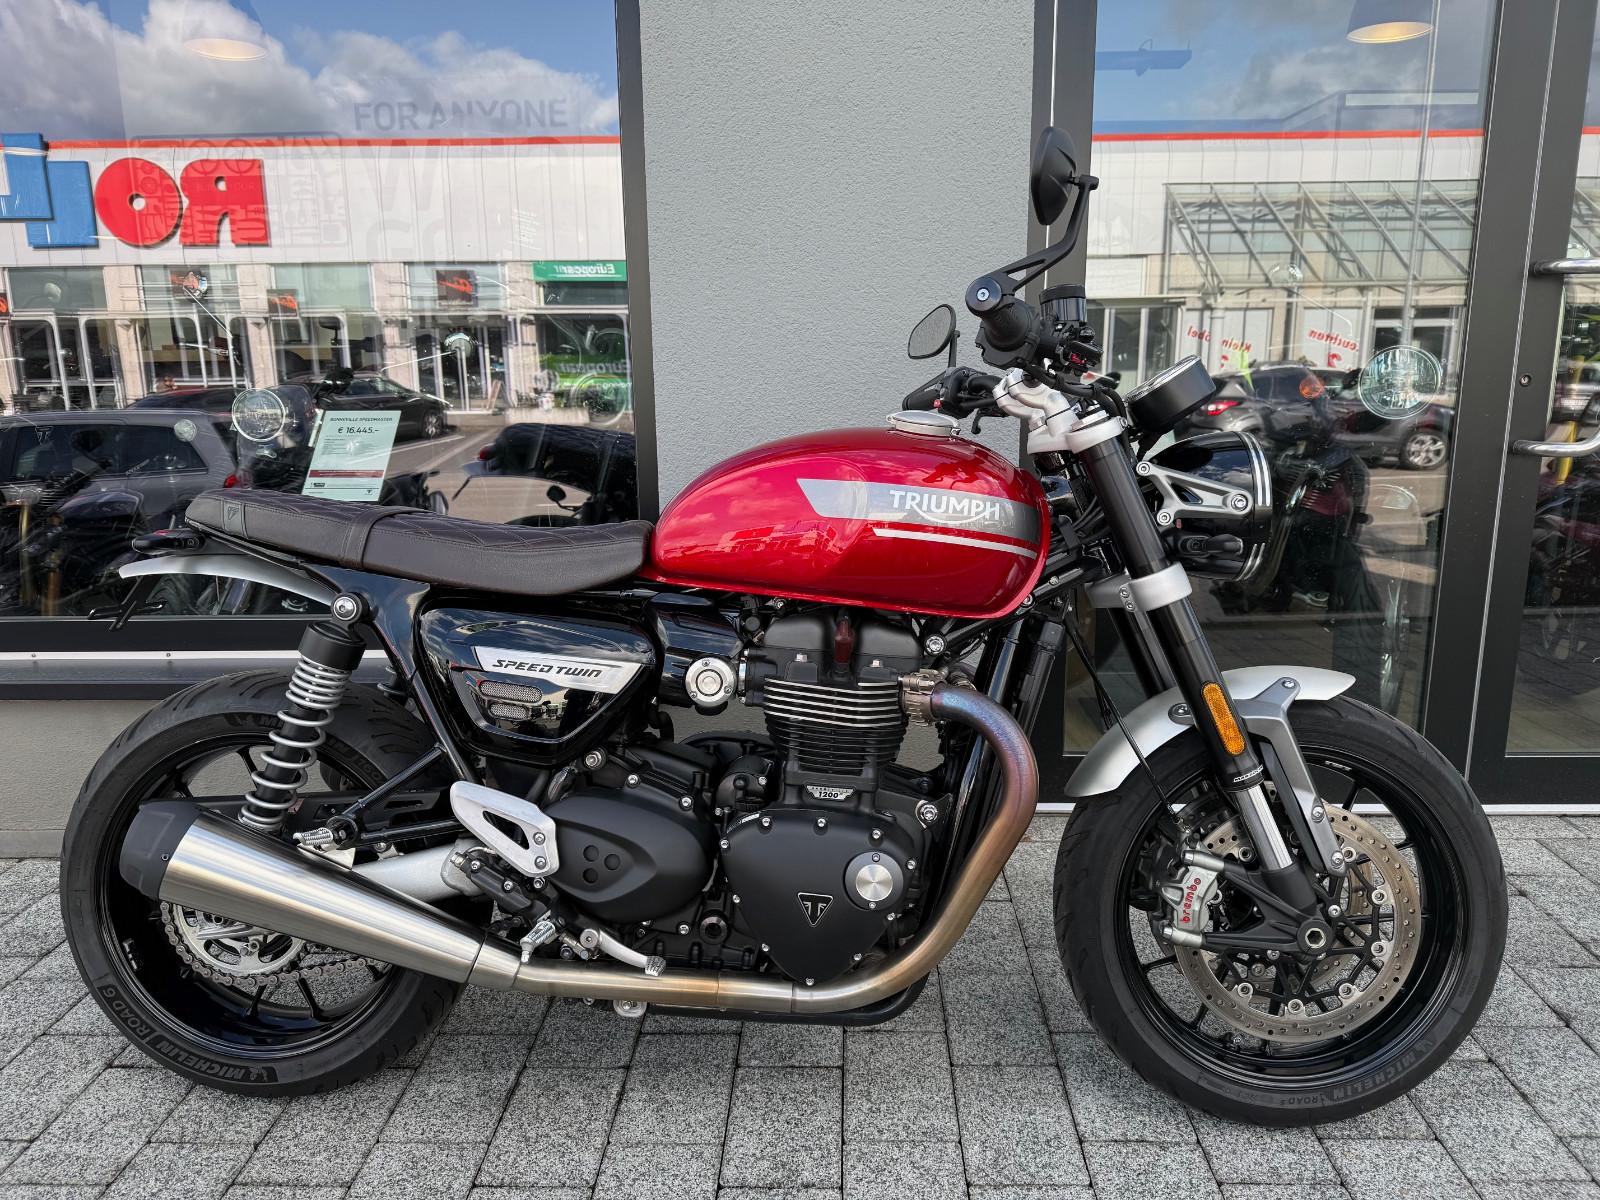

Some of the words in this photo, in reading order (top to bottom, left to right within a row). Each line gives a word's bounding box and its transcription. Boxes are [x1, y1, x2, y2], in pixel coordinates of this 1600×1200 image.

[353, 101, 419, 132] FOR
[429, 98, 568, 130] ANYONE
[337, 426, 344, 434] €
[889, 489, 1001, 523] TRIUMPH
[492, 658, 554, 674] SPEED
[556, 666, 603, 679] TWIN
[818, 791, 840, 799] 1200
[1180, 877, 1202, 924] brembo
[102, 985, 117, 999] 6
[112, 1000, 151, 1039] ROAD
[155, 1040, 247, 1081] MICHELIN
[1332, 1050, 1416, 1101] MICHELIN
[1287, 1095, 1319, 1107] ROAD
